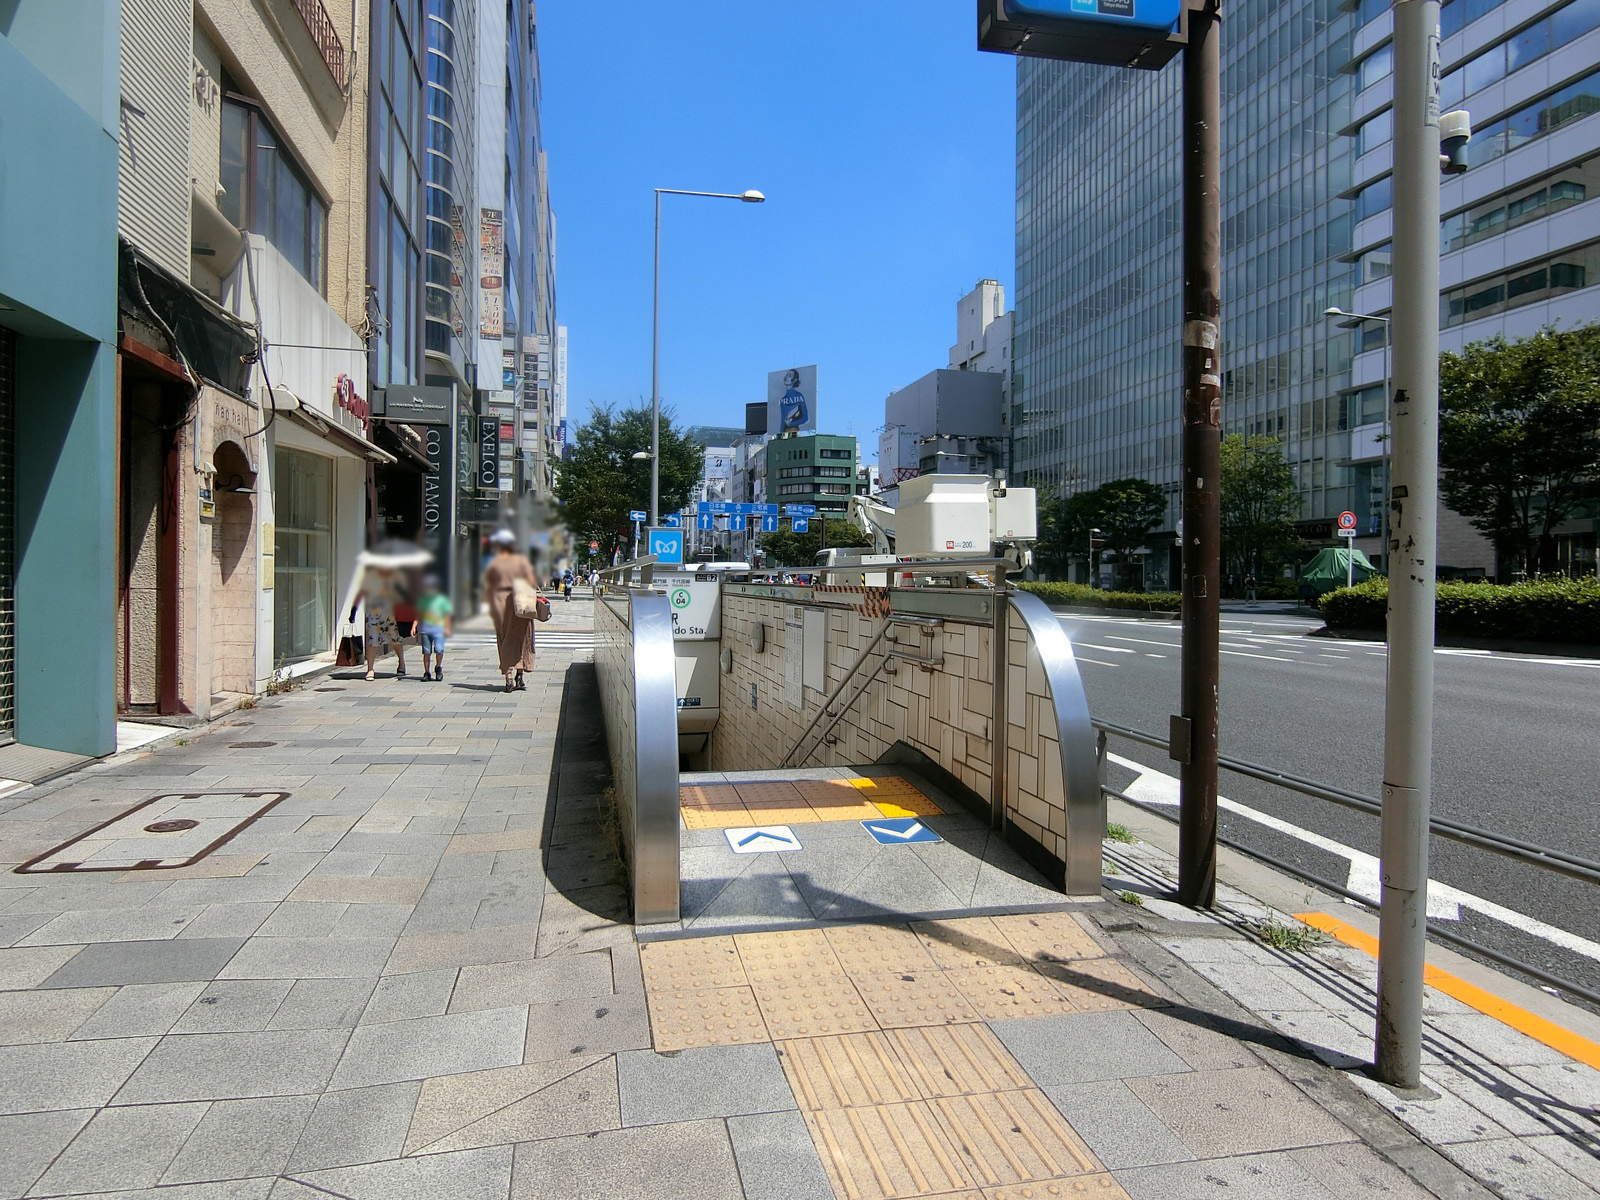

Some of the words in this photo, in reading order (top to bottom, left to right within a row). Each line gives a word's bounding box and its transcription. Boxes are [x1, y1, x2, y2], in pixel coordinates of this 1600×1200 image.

[778, 396, 804, 405] PRADA
[482, 422, 495, 483] EXELCO
[689, 626, 707, 635] Sta.
